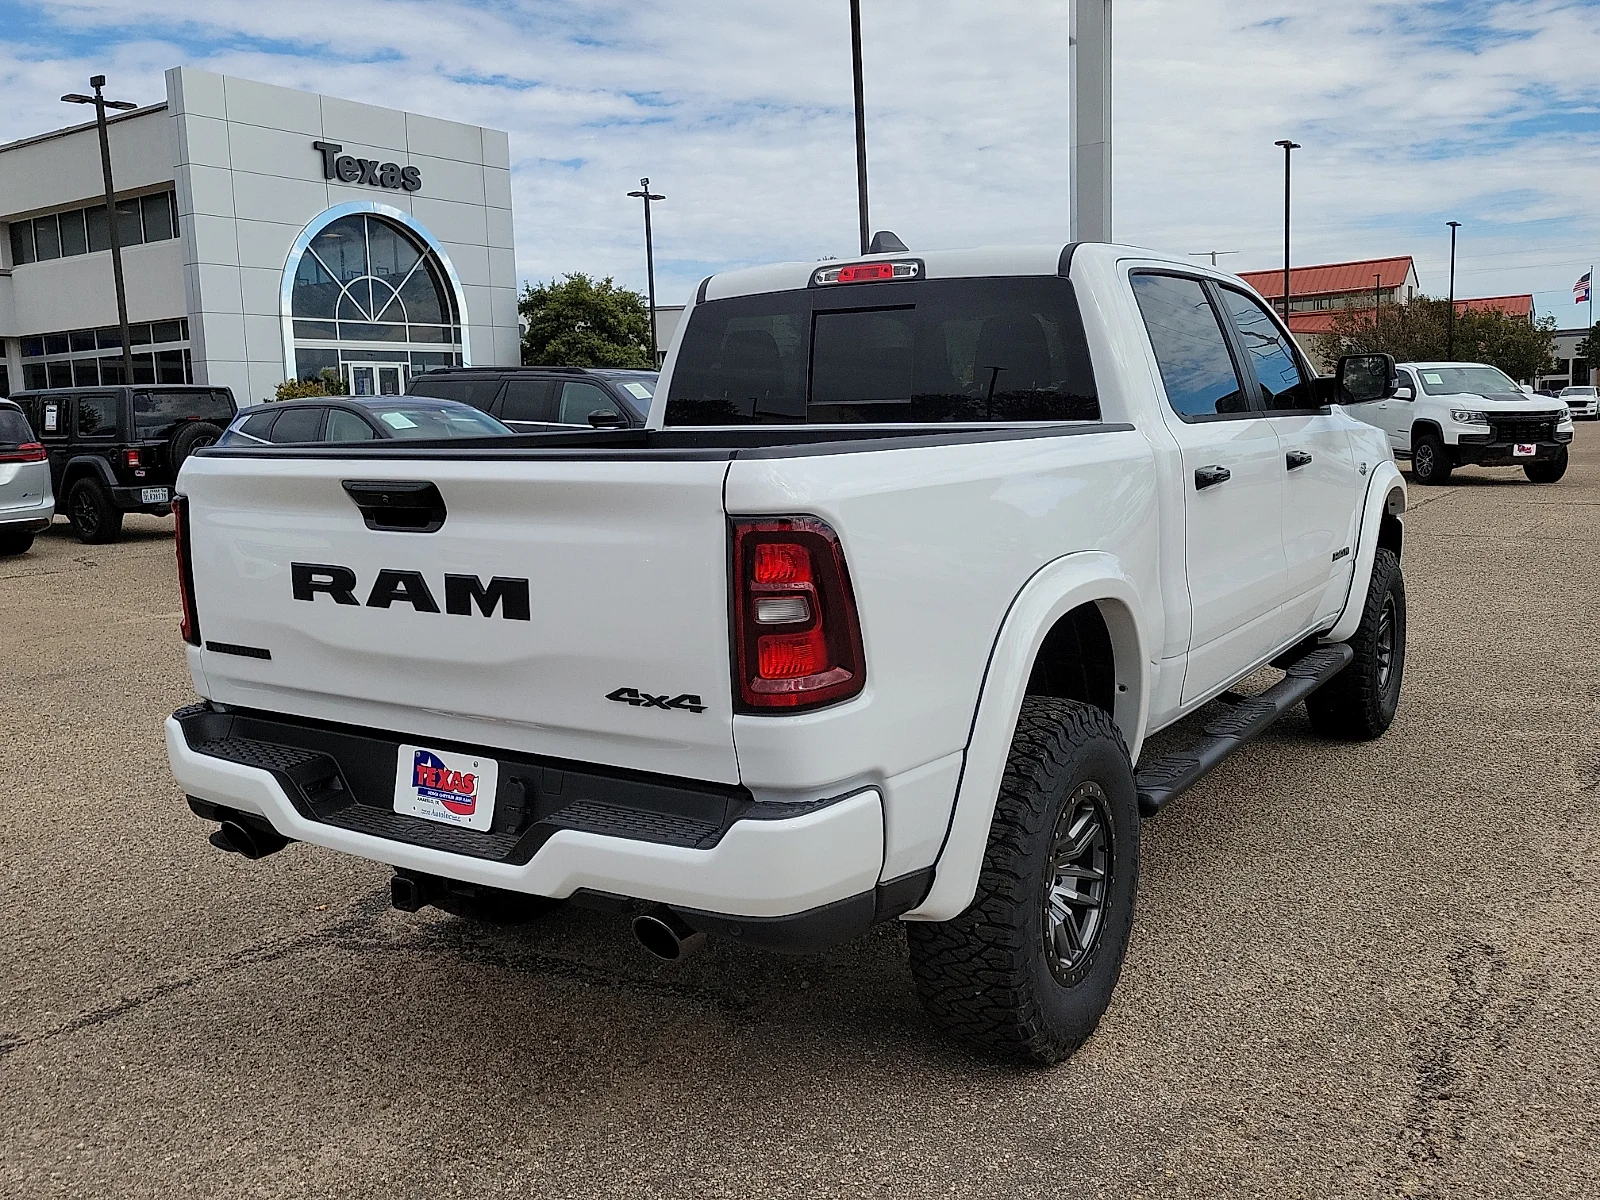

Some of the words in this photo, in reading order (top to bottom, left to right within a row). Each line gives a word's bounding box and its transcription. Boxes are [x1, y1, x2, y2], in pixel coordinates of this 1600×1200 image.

[313, 141, 422, 191] Texas
[291, 562, 531, 621] RAM
[605, 687, 708, 714] 4x4
[416, 765, 476, 794] TEXAS
